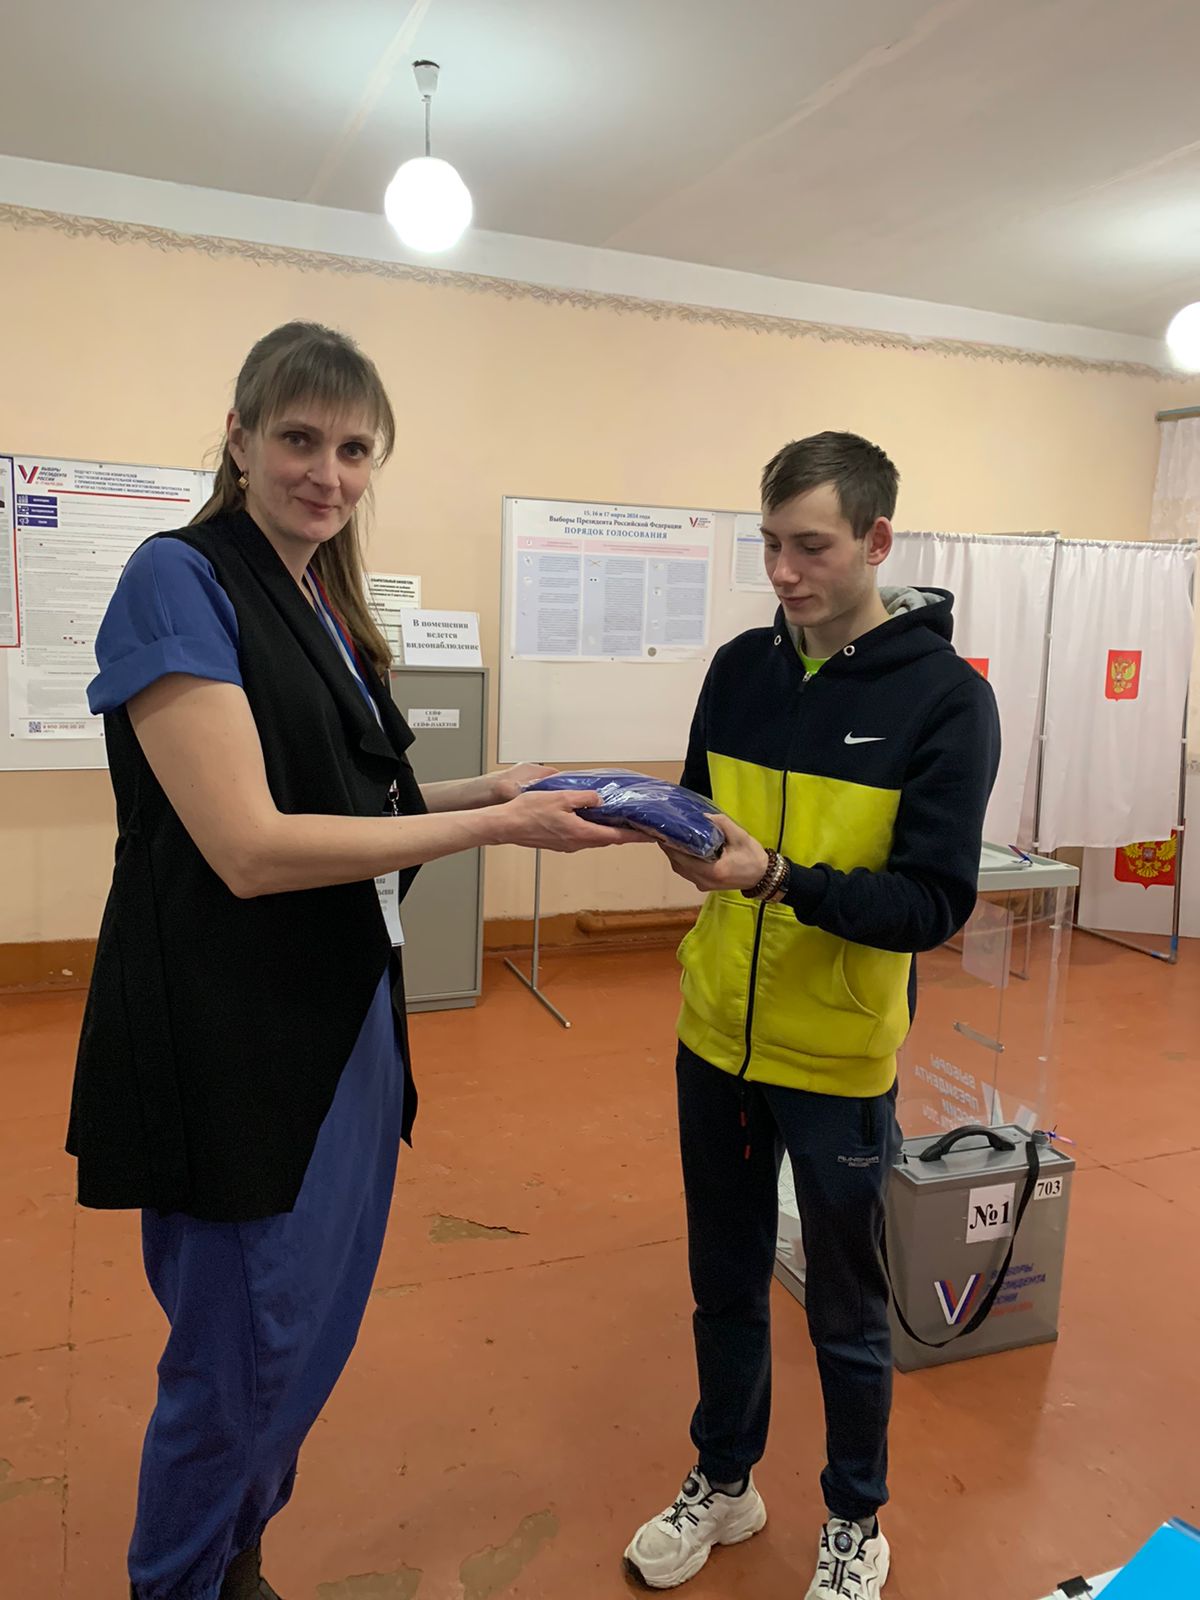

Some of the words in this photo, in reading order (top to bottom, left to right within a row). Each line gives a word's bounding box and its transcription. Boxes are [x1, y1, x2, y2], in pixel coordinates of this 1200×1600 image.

[549, 515, 575, 524] Выборы
[577, 517, 612, 526] Президента
[614, 519, 648, 528] Российской
[650, 521, 682, 530] Федерации
[564, 527, 604, 536] ПОРЯДОК
[606, 529, 668, 539] ГОЛОСОВАНИЯ
[413, 619, 420, 627] В
[421, 621, 469, 629] помещении
[406, 641, 480, 651] видеонаблюдение
[1037, 1180, 1061, 1197] 703
[969, 1201, 1010, 1230] №1
